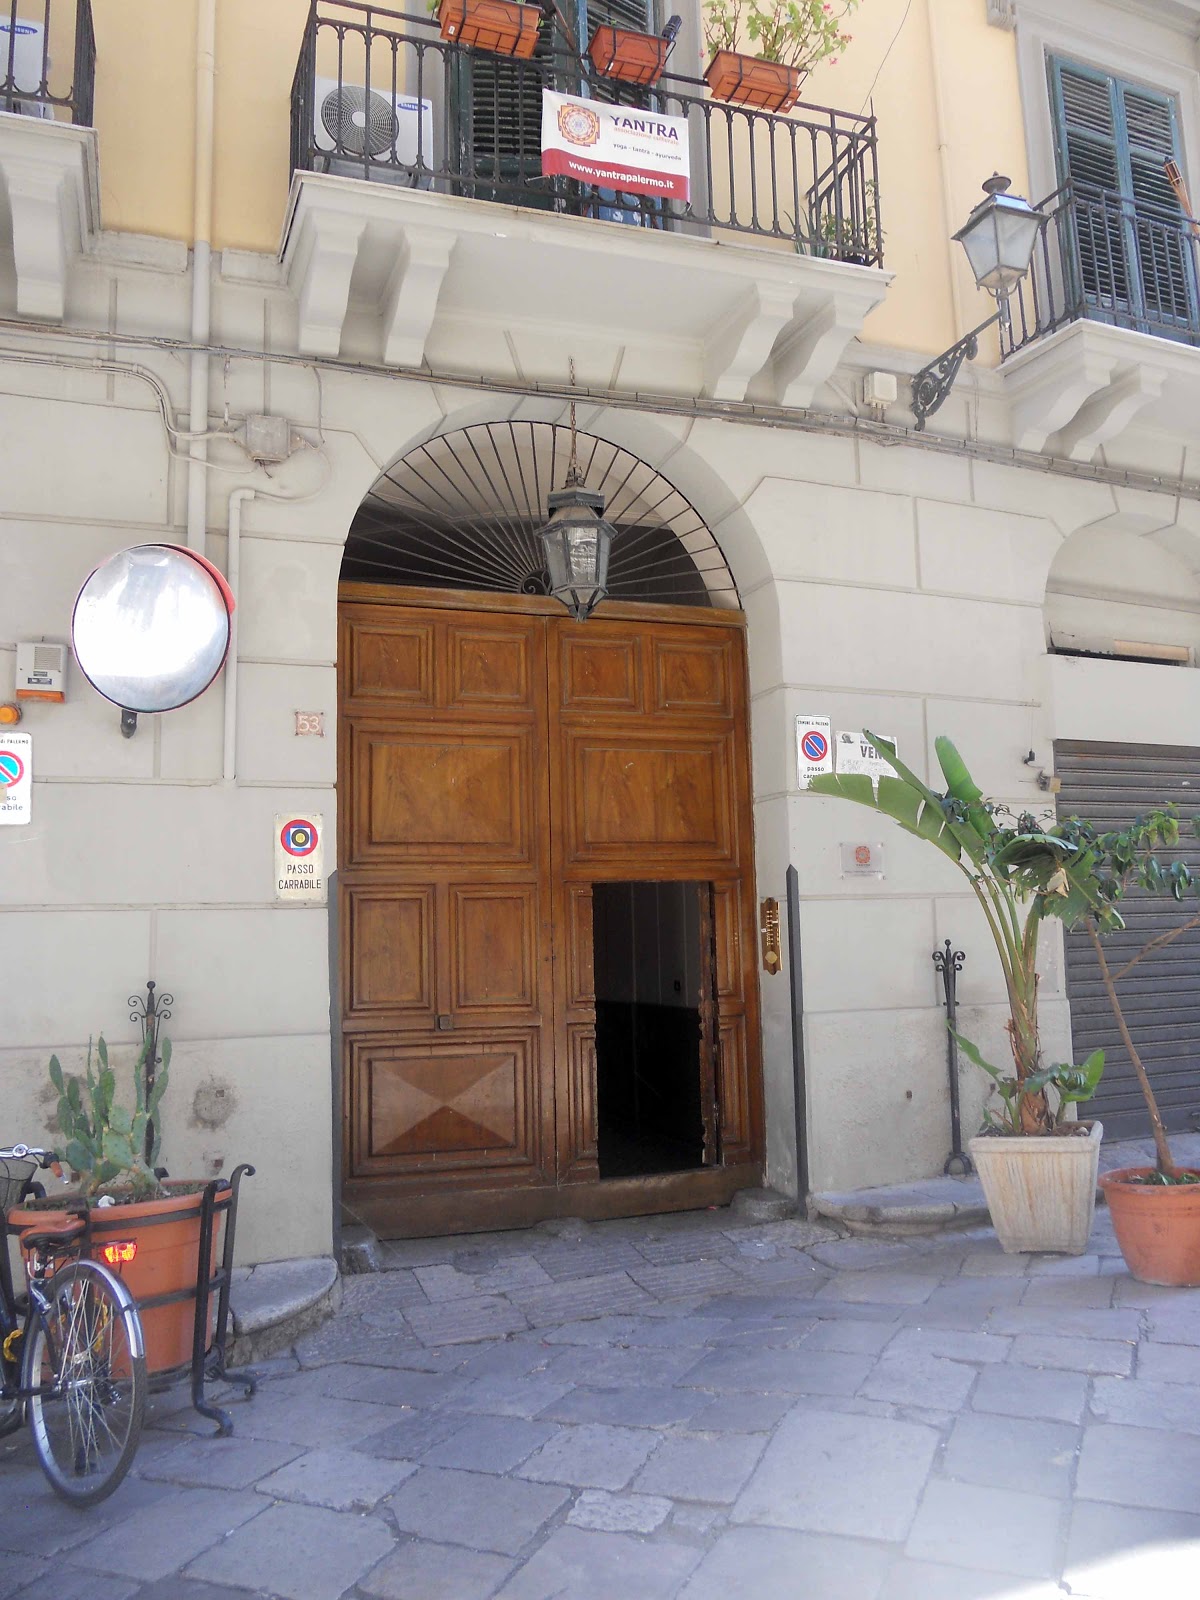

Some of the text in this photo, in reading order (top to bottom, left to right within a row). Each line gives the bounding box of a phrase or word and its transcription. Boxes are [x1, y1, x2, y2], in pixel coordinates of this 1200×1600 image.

[610, 115, 679, 141] YANTRA
[632, 146, 651, 155] tantra
[655, 152, 682, 161] ayurveda
[568, 160, 674, 189] www.yantrapalermo.it
[299, 715, 320, 732] 53
[287, 864, 314, 874] PASSO
[278, 878, 322, 890] CARRABILE
